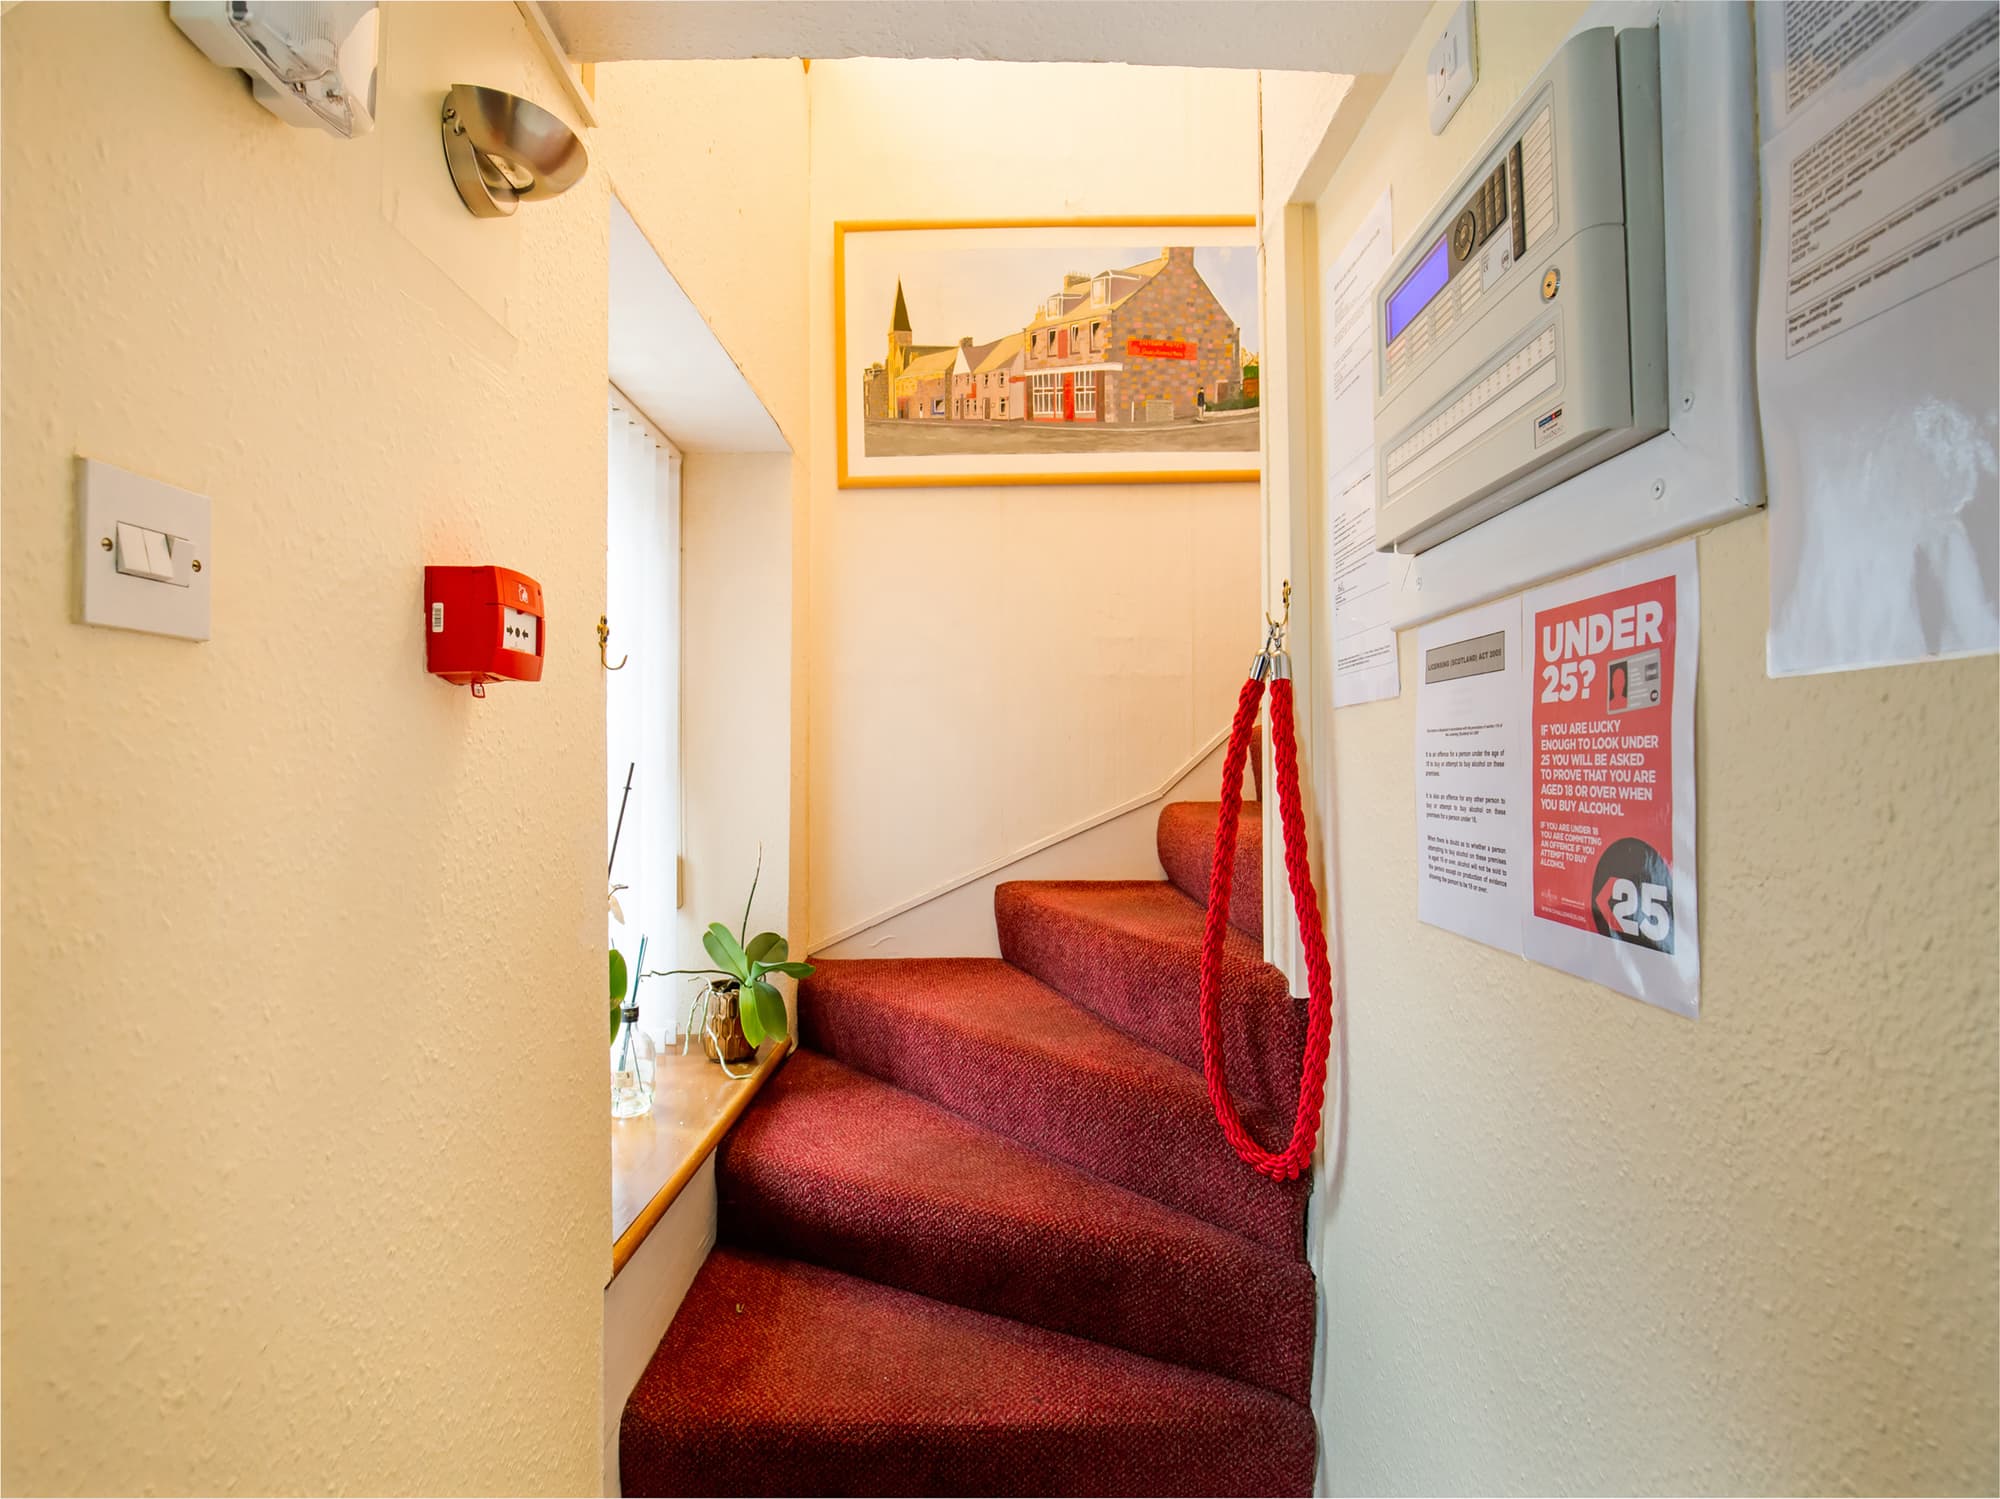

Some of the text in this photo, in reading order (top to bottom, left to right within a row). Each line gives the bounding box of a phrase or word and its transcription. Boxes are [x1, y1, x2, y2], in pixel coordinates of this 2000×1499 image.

[1543, 601, 1663, 662] UNDER
[1479, 651, 1488, 659] ACT
[1541, 659, 1596, 703] 25?
[1541, 720, 1621, 736] IF YOU ARE LUCKY
[1541, 736, 1658, 751] ENOUGH TO LOOK UNDER
[1541, 753, 1644, 766] 25 YOU WILL BE ASKED
[1541, 769, 1656, 783] TO PROVE THAT YOU ARE
[1541, 784, 1652, 800] AGED 18 OR OVER WHEN
[1541, 798, 1624, 816] YOU BUY ALCOHOL
[1547, 822, 1557, 830] YOU
[1559, 823, 1569, 832] ARE
[1571, 824, 1591, 834] UNDER
[1553, 832, 1564, 840] ARE
[1565, 833, 1602, 846] COMMITTING
[1550, 842, 1574, 852] OFFENCE
[1576, 844, 1582, 852] IF
[1583, 846, 1594, 855] YOU
[1541, 849, 1587, 864] ATTEMPT TO BUY
[1612, 878, 1670, 941] 25
